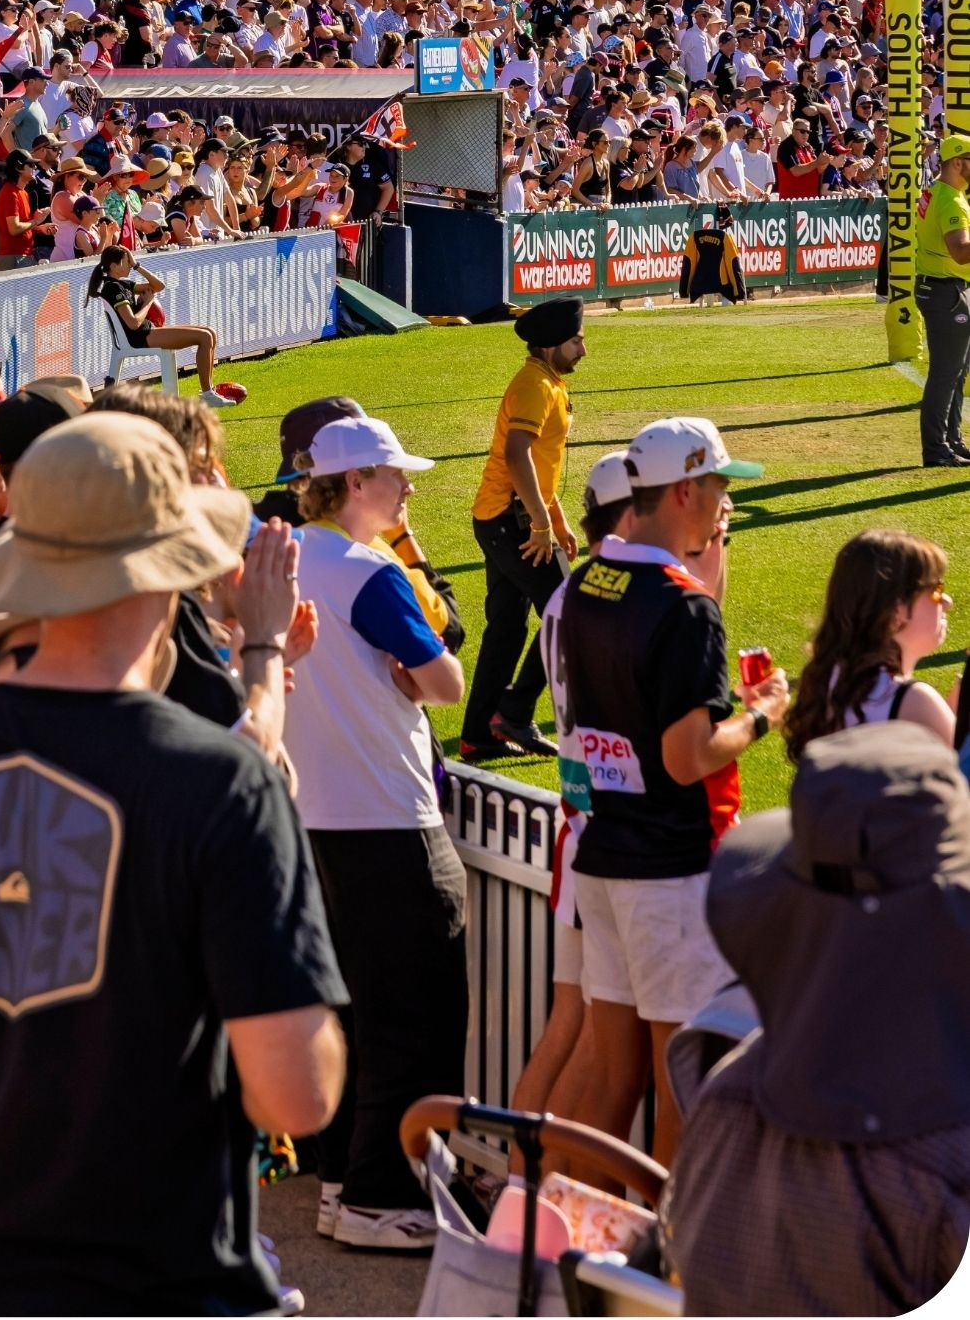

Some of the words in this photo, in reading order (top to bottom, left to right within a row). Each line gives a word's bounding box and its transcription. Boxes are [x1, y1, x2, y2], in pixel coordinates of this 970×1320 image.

[422, 47, 441, 67] GATHER
[888, 13, 912, 117] SOUTH
[114, 84, 310, 97] FINDEX
[796, 210, 882, 246] BUNNINGS
[888, 131, 912, 305] AUSTRALIA
[512, 223, 596, 262] BUNNINGS
[606, 219, 689, 257] BUNNINGS
[802, 237, 876, 269] warehouse
[519, 255, 591, 289] warehouse
[612, 249, 683, 282] warehouse
[187, 247, 333, 353] WAREHOUSE
[583, 562, 632, 594] RSEA
